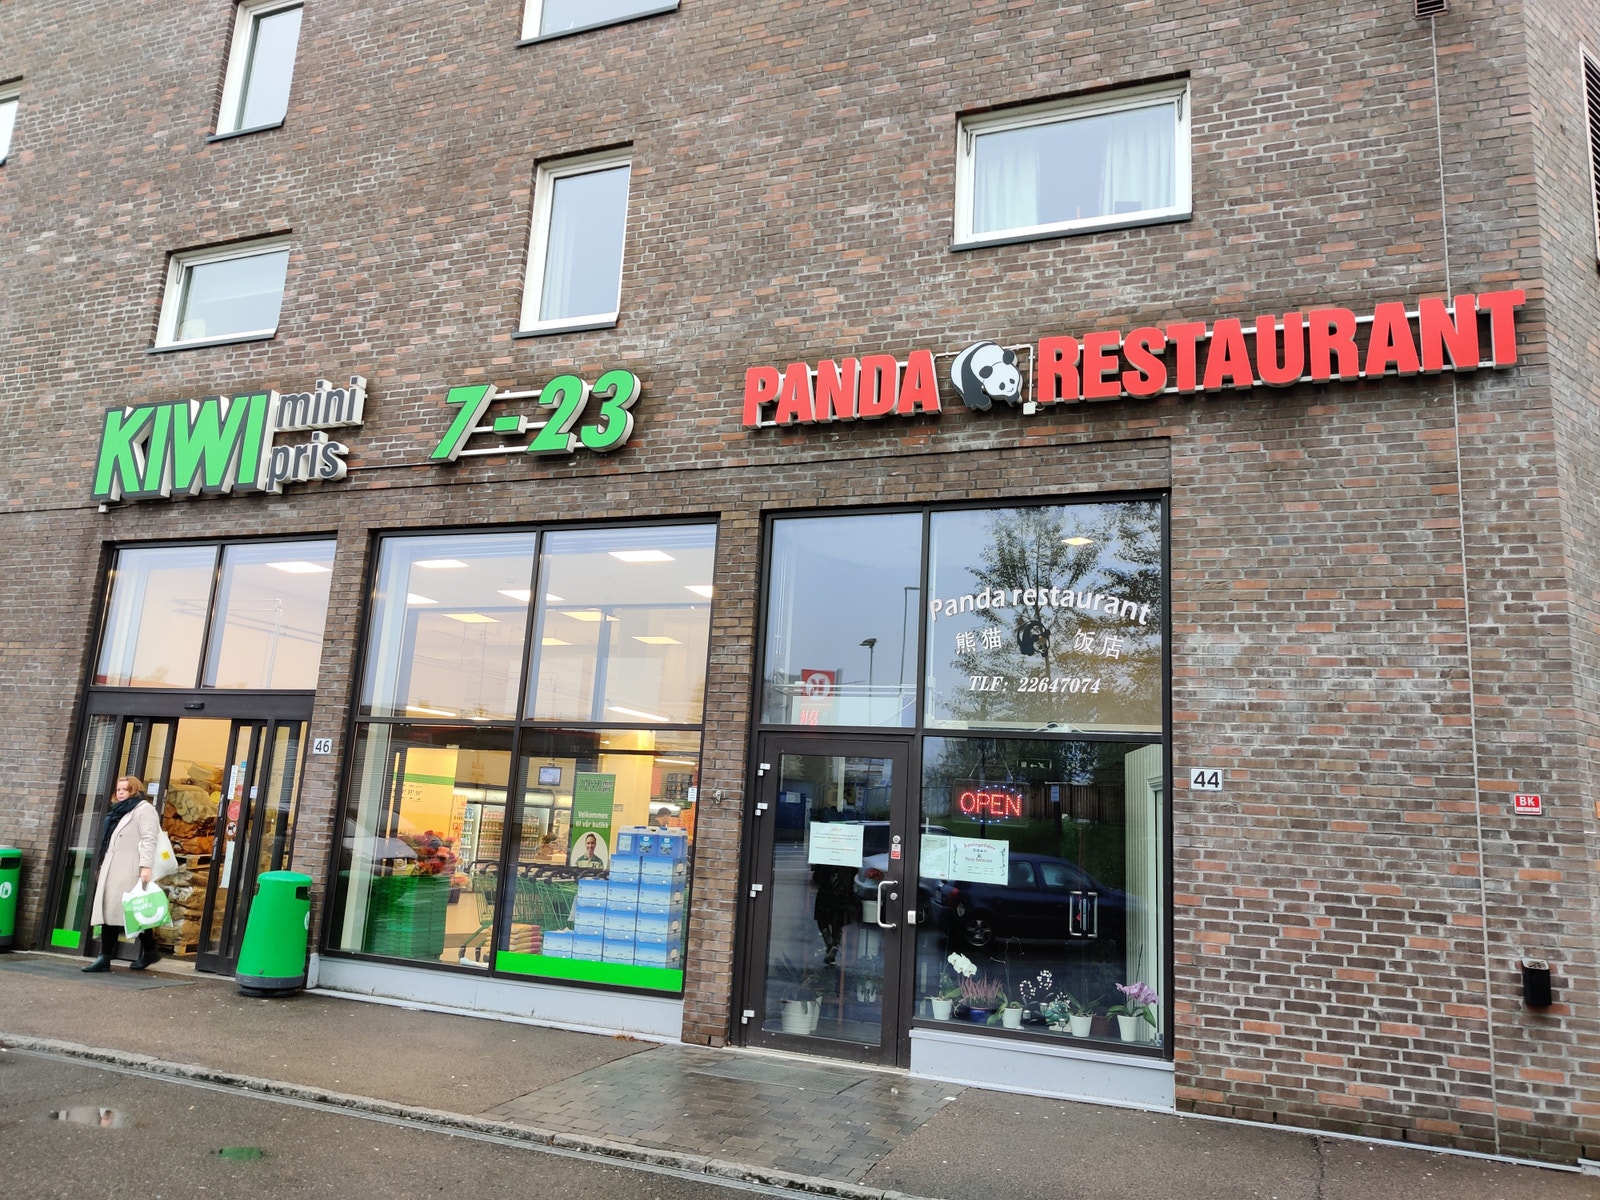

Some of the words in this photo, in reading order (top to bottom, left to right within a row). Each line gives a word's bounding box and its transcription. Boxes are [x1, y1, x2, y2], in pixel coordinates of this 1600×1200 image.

[743, 349, 942, 429] PANDA
[1037, 288, 1527, 404] RESTAURANT
[276, 375, 367, 431] mini
[430, 369, 641, 463] 7-23
[90, 389, 280, 501] KIWI
[266, 431, 349, 494] pris
[929, 587, 1006, 622] Panda
[1012, 588, 1151, 626] restaurant
[955, 627, 1003, 654] 熊猫
[1073, 628, 1125, 660] 饭店
[969, 675, 1009, 692] TLF:
[1017, 676, 1101, 694] 22647074
[315, 739, 331, 753] 46
[1193, 770, 1220, 788] 44
[578, 811, 608, 819] Velkommen
[960, 791, 1022, 817] OPEN
[1519, 796, 1535, 807] BK
